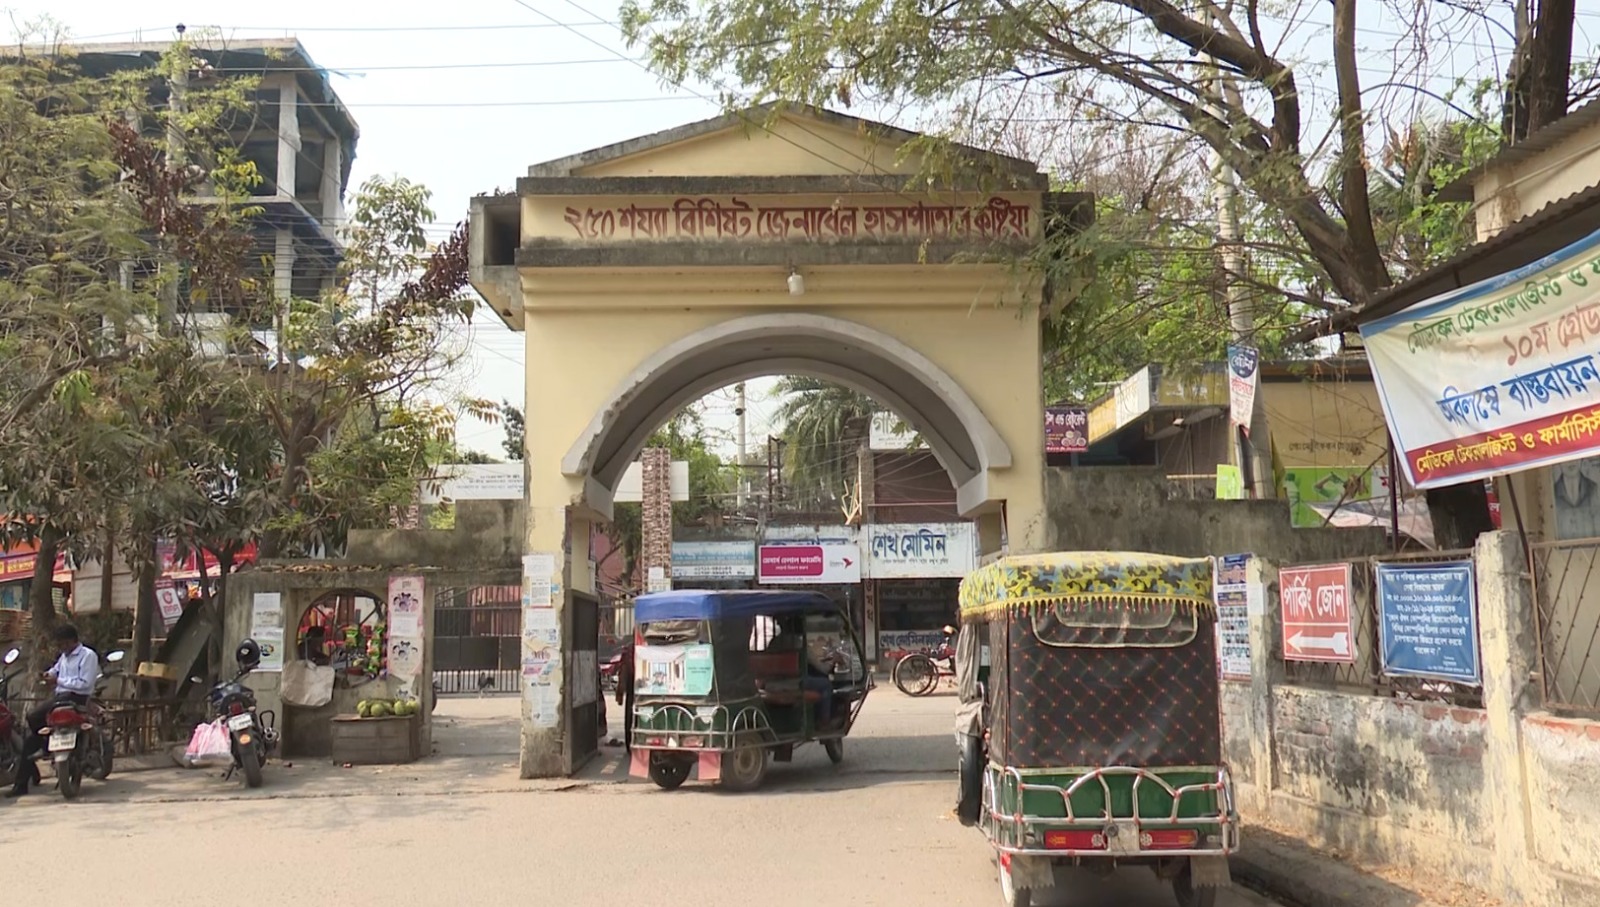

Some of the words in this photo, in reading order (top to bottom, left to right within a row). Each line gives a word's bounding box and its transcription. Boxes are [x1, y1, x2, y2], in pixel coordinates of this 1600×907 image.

[564, 205, 616, 239] ২৫০
[1567, 266, 1588, 287] ও
[1500, 355, 1600, 412] বাস্তবায়ন
[1520, 432, 1536, 449] ও
[872, 531, 898, 557] শেখ
[901, 528, 947, 557] মোমিন
[1283, 573, 1314, 620] পার্কিং
[1316, 580, 1346, 619] জোন
